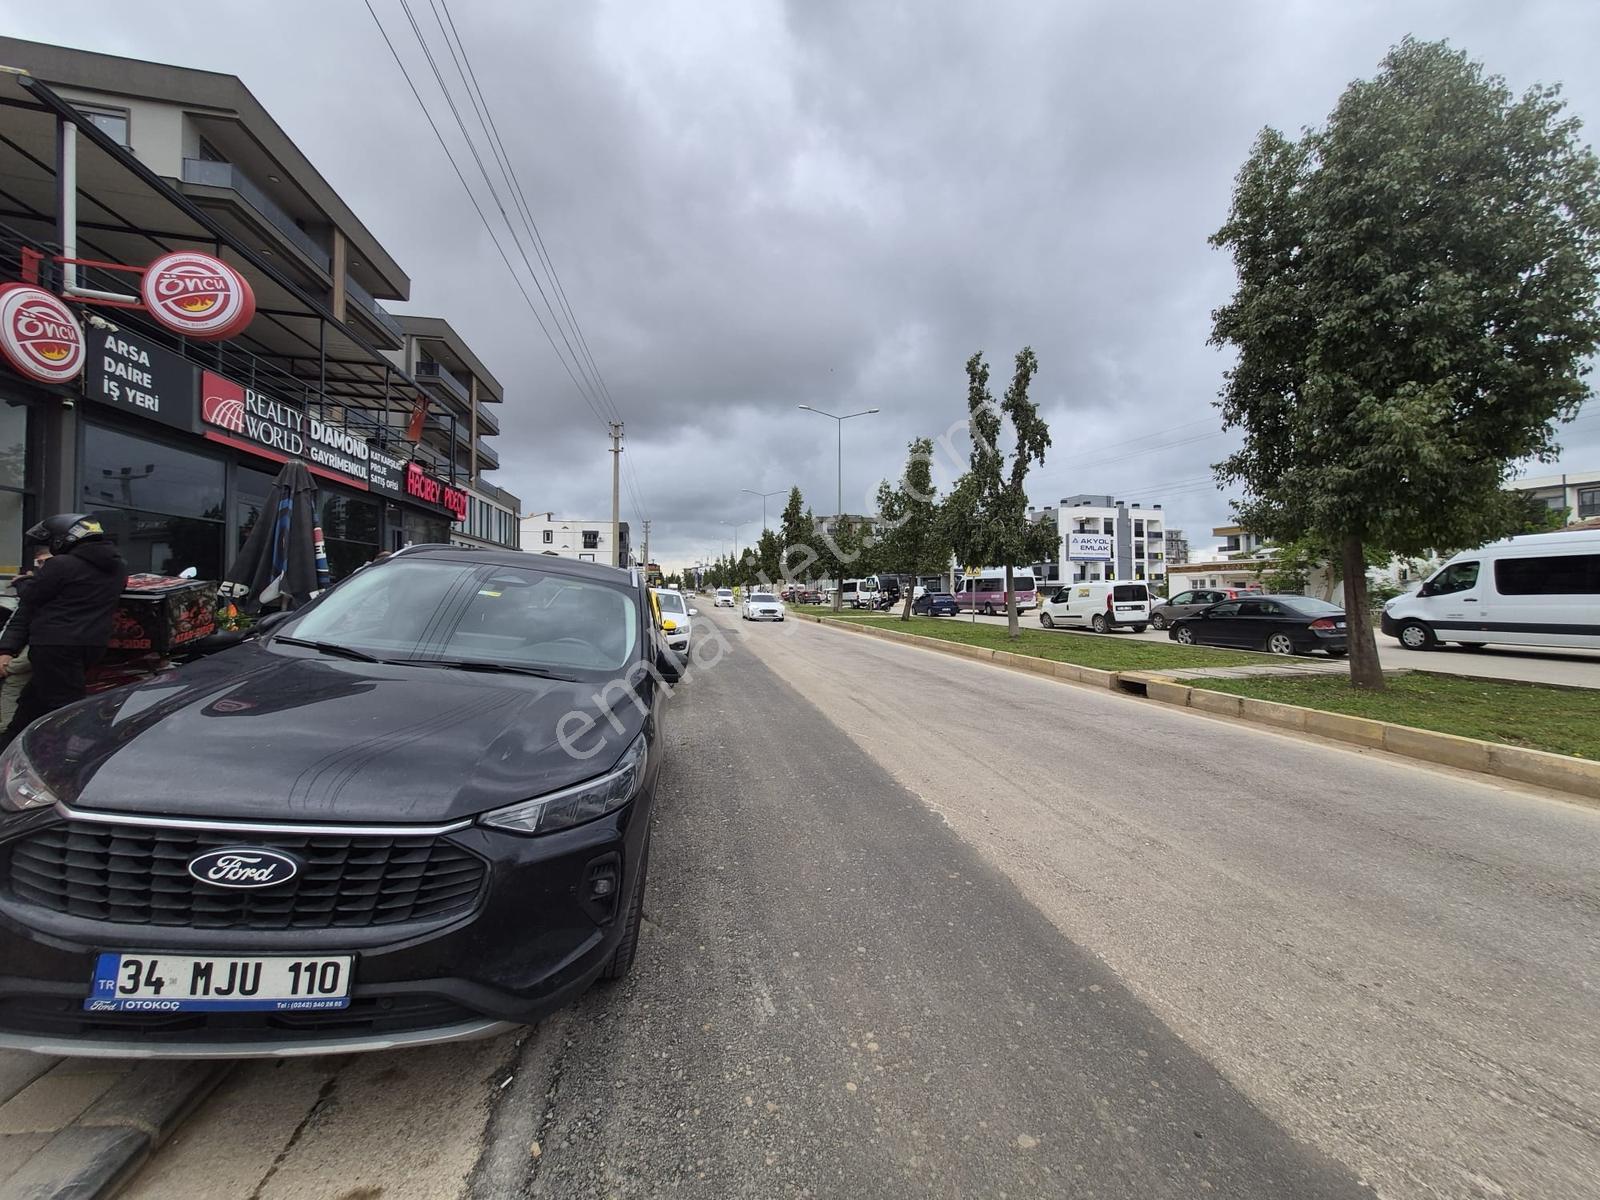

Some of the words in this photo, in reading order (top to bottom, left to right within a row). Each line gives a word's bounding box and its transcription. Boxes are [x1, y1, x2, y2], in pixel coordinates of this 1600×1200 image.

[158, 274, 225, 296] Öncü
[17, 311, 77, 340] Öncü
[104, 335, 150, 367] ARSA
[103, 356, 152, 389] DAİRE
[103, 377, 120, 401] İŞ
[125, 386, 159, 413] YERİ
[246, 388, 303, 432] REALTY
[245, 414, 303, 455] WORLD
[310, 419, 369, 460] DIAMOND
[310, 446, 369, 479] GAYRİMENKUL
[370, 462, 387, 476] PROJE
[207, 855, 277, 882] Ford
[98, 979, 115, 991] TR
[118, 959, 165, 995] 34
[189, 961, 262, 996] MJU
[288, 961, 341, 994] 110
[90, 1000, 117, 1010] Ford
[125, 1001, 180, 1011] OTOKOÇ
